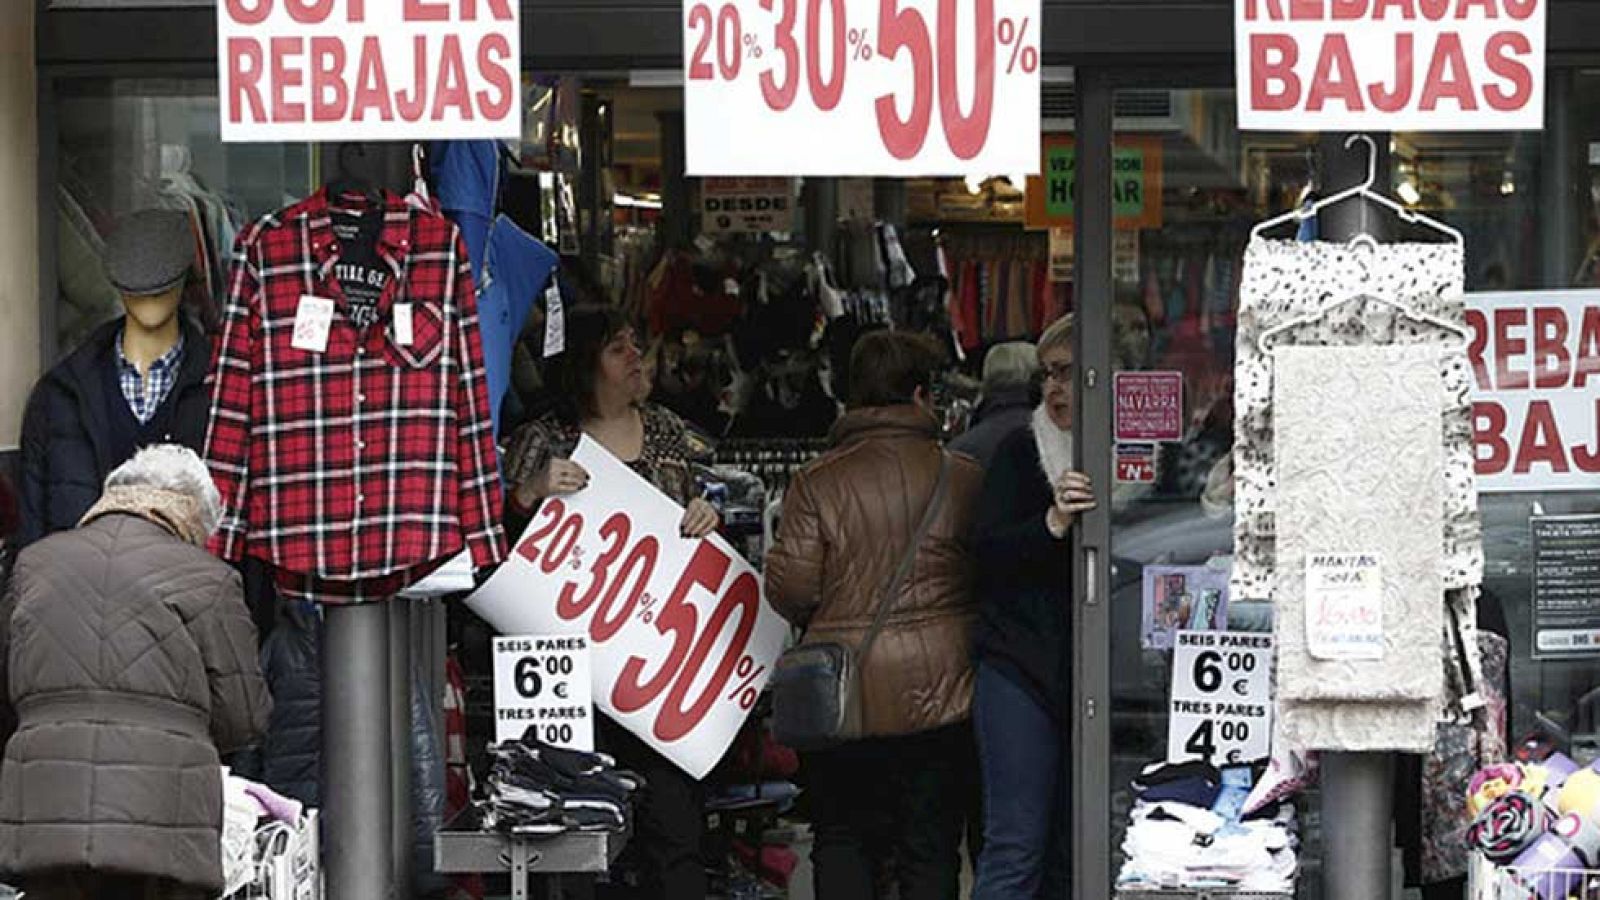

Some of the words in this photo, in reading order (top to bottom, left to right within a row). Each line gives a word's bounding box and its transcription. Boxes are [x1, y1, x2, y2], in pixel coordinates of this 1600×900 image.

[227, 33, 513, 123] REBAJAS
[688, 2, 763, 81] 20%
[758, 0, 873, 111] 30%
[875, 0, 1038, 161] 50%
[1249, 31, 1534, 114] BAJAS
[705, 198, 786, 210] DESDE
[1464, 306, 1600, 390] REBA
[1471, 398, 1600, 475] BAJ
[516, 497, 585, 575] 20%
[556, 511, 660, 643] 30%
[611, 538, 765, 743] 50%
[497, 640, 532, 653] SEIS
[536, 638, 587, 651] PARES
[1179, 634, 1214, 646] SEIS
[1220, 635, 1272, 648] PARES
[552, 681, 569, 699] €
[1232, 679, 1249, 696] €
[498, 708, 535, 720] TRES
[538, 707, 587, 719] PARES
[1173, 701, 1212, 714] TRES
[1216, 703, 1266, 717] PARES
